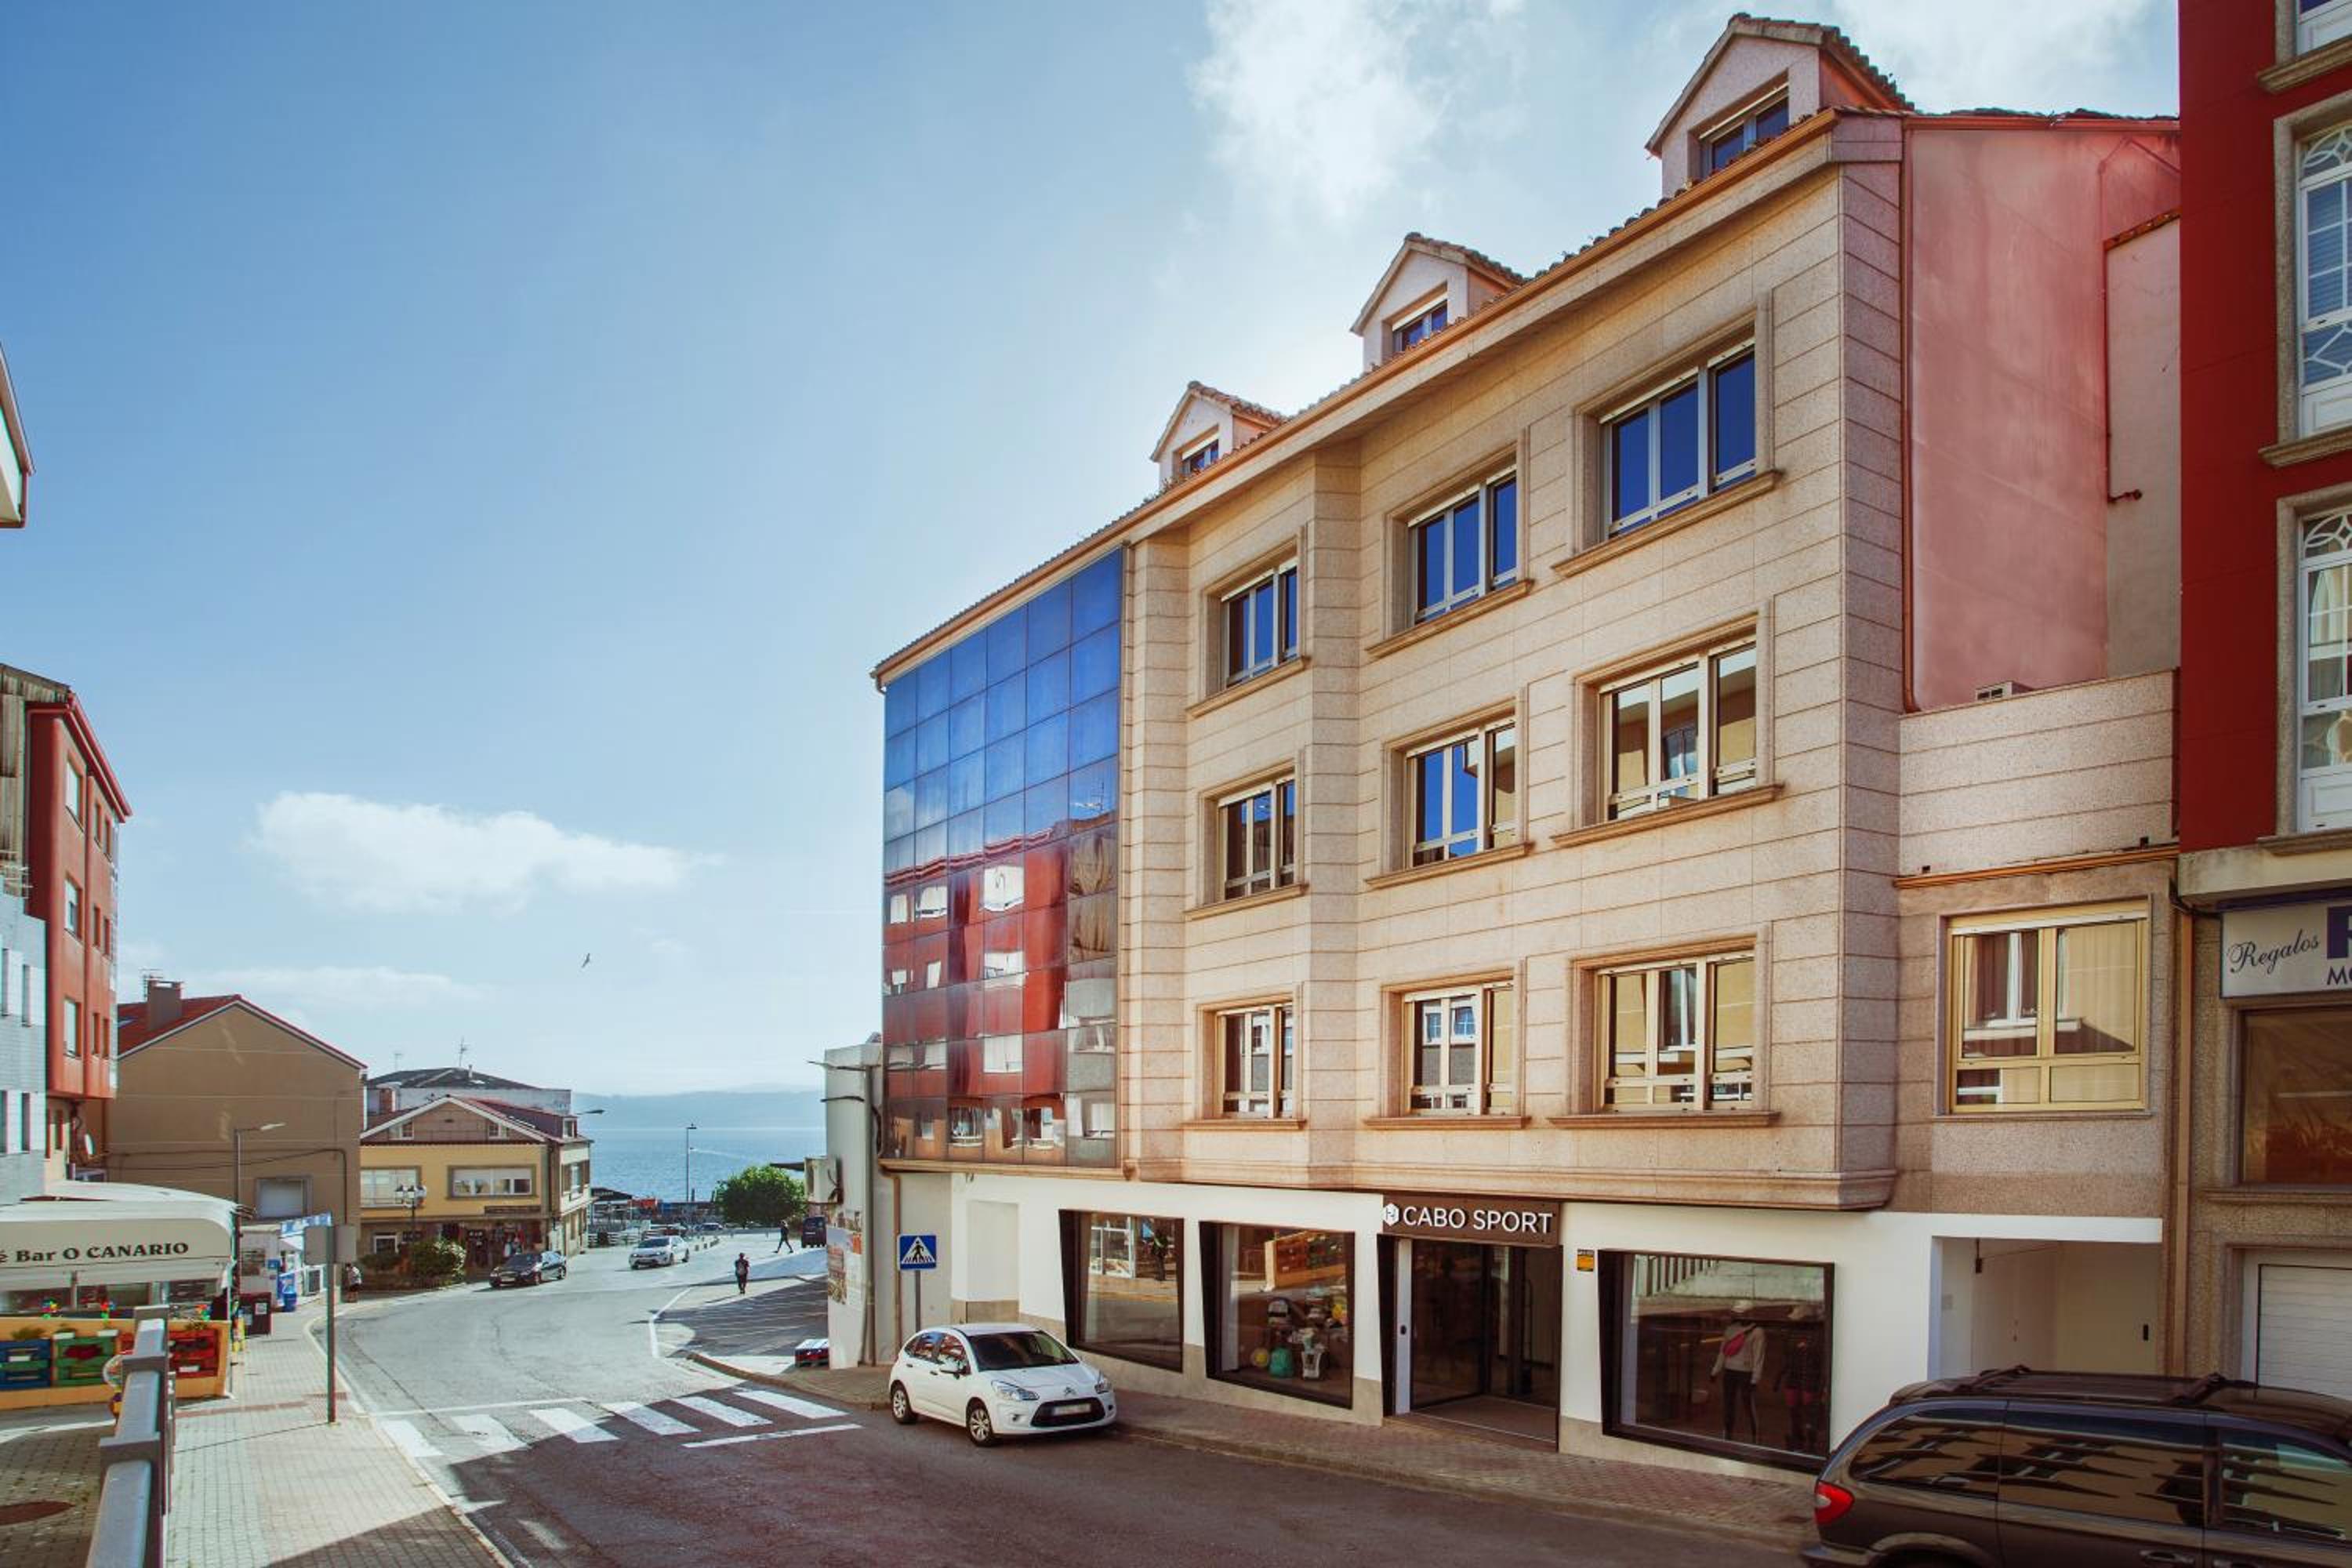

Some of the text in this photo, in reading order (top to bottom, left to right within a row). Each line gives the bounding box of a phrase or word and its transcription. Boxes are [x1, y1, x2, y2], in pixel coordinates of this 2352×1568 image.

[2229, 928, 2321, 975] Regalos
[2327, 965, 2352, 985] M
[1402, 1206, 1553, 1233] CABO SPORT
[16, 1250, 57, 1262] Bar
[63, 1247, 80, 1260] O
[86, 1242, 189, 1258] CANARIO
